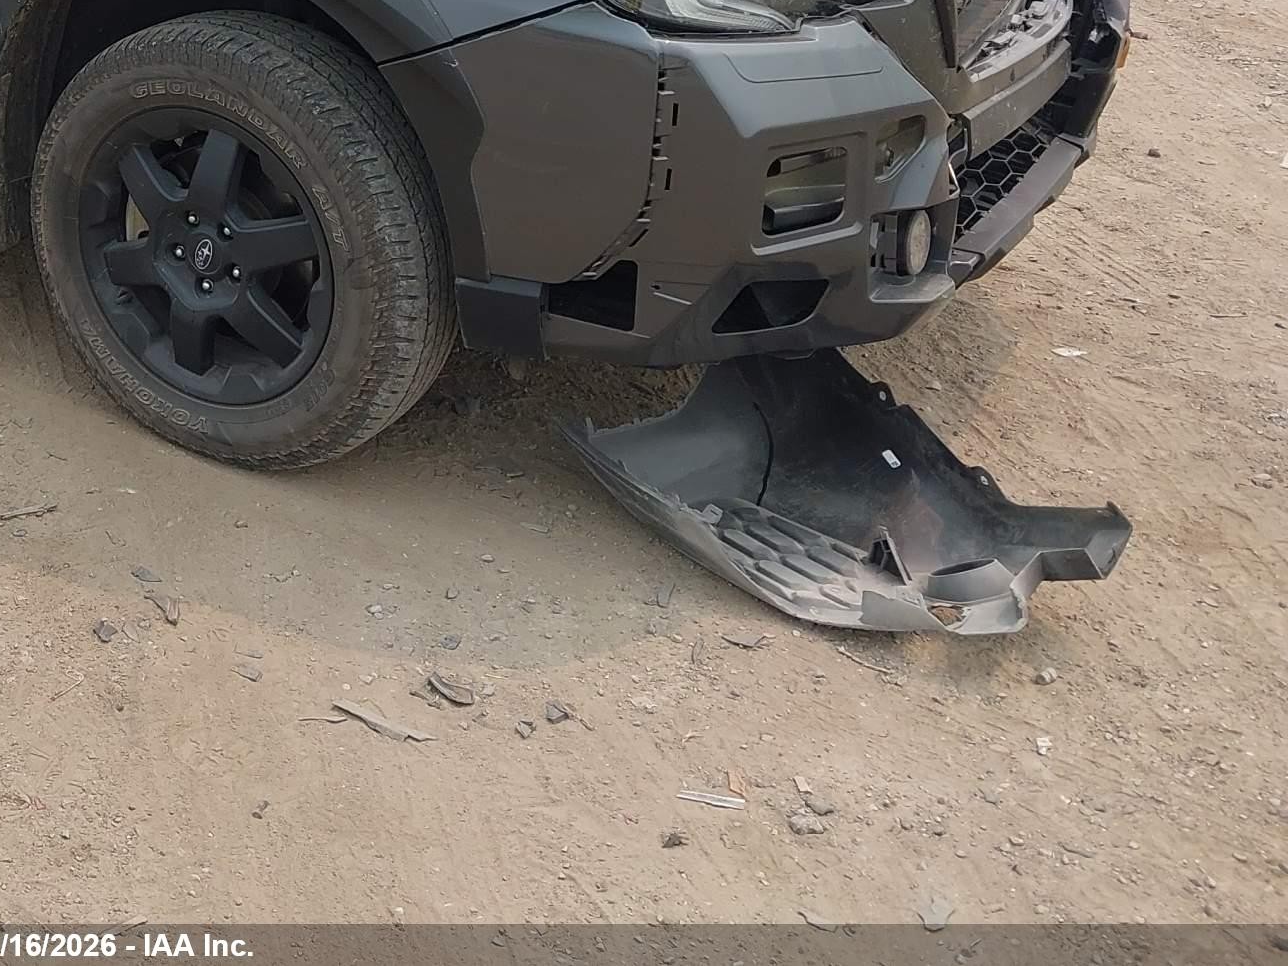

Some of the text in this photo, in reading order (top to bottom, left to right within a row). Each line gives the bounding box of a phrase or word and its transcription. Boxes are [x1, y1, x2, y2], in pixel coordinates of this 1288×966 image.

[128, 79, 351, 253] GEOLANDAR A/T
[80, 318, 209, 435] YOKOHAMA
